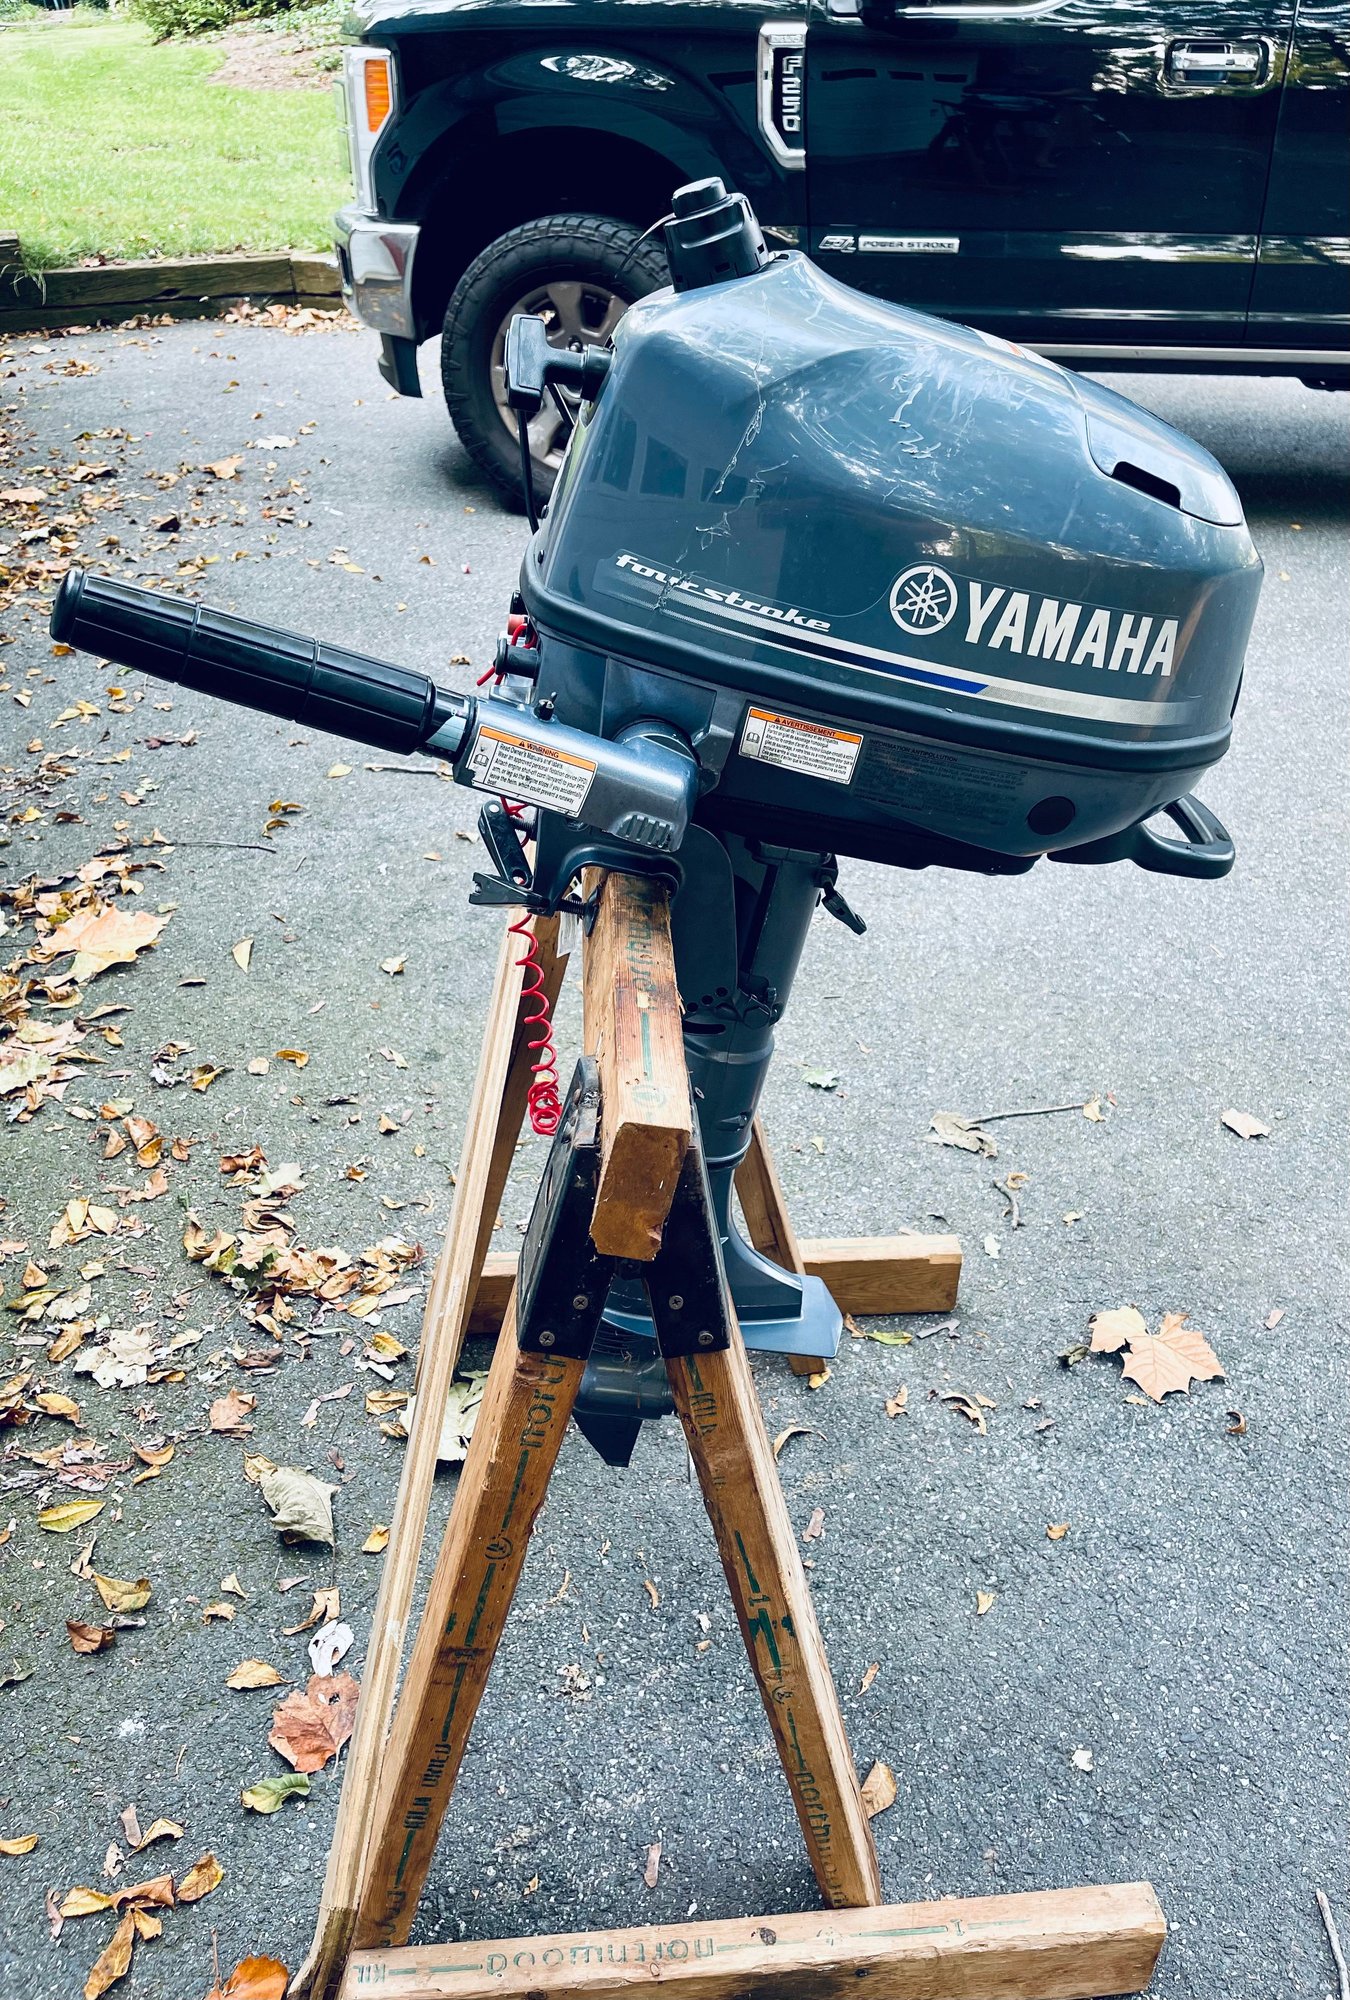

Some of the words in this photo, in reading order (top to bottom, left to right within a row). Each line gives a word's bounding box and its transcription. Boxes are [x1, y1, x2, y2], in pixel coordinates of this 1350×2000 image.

[863, 239, 903, 248] POWER
[907, 240, 954, 249] STROKE
[703, 587, 831, 632] stroke
[965, 581, 1178, 677] YAMAHA
[783, 720, 836, 737] AVERTISSEMENT
[526, 743, 560, 758] WARNING
[869, 740, 910, 753] INFORMATION
[912, 749, 958, 762] ANTIPOLLUTION
